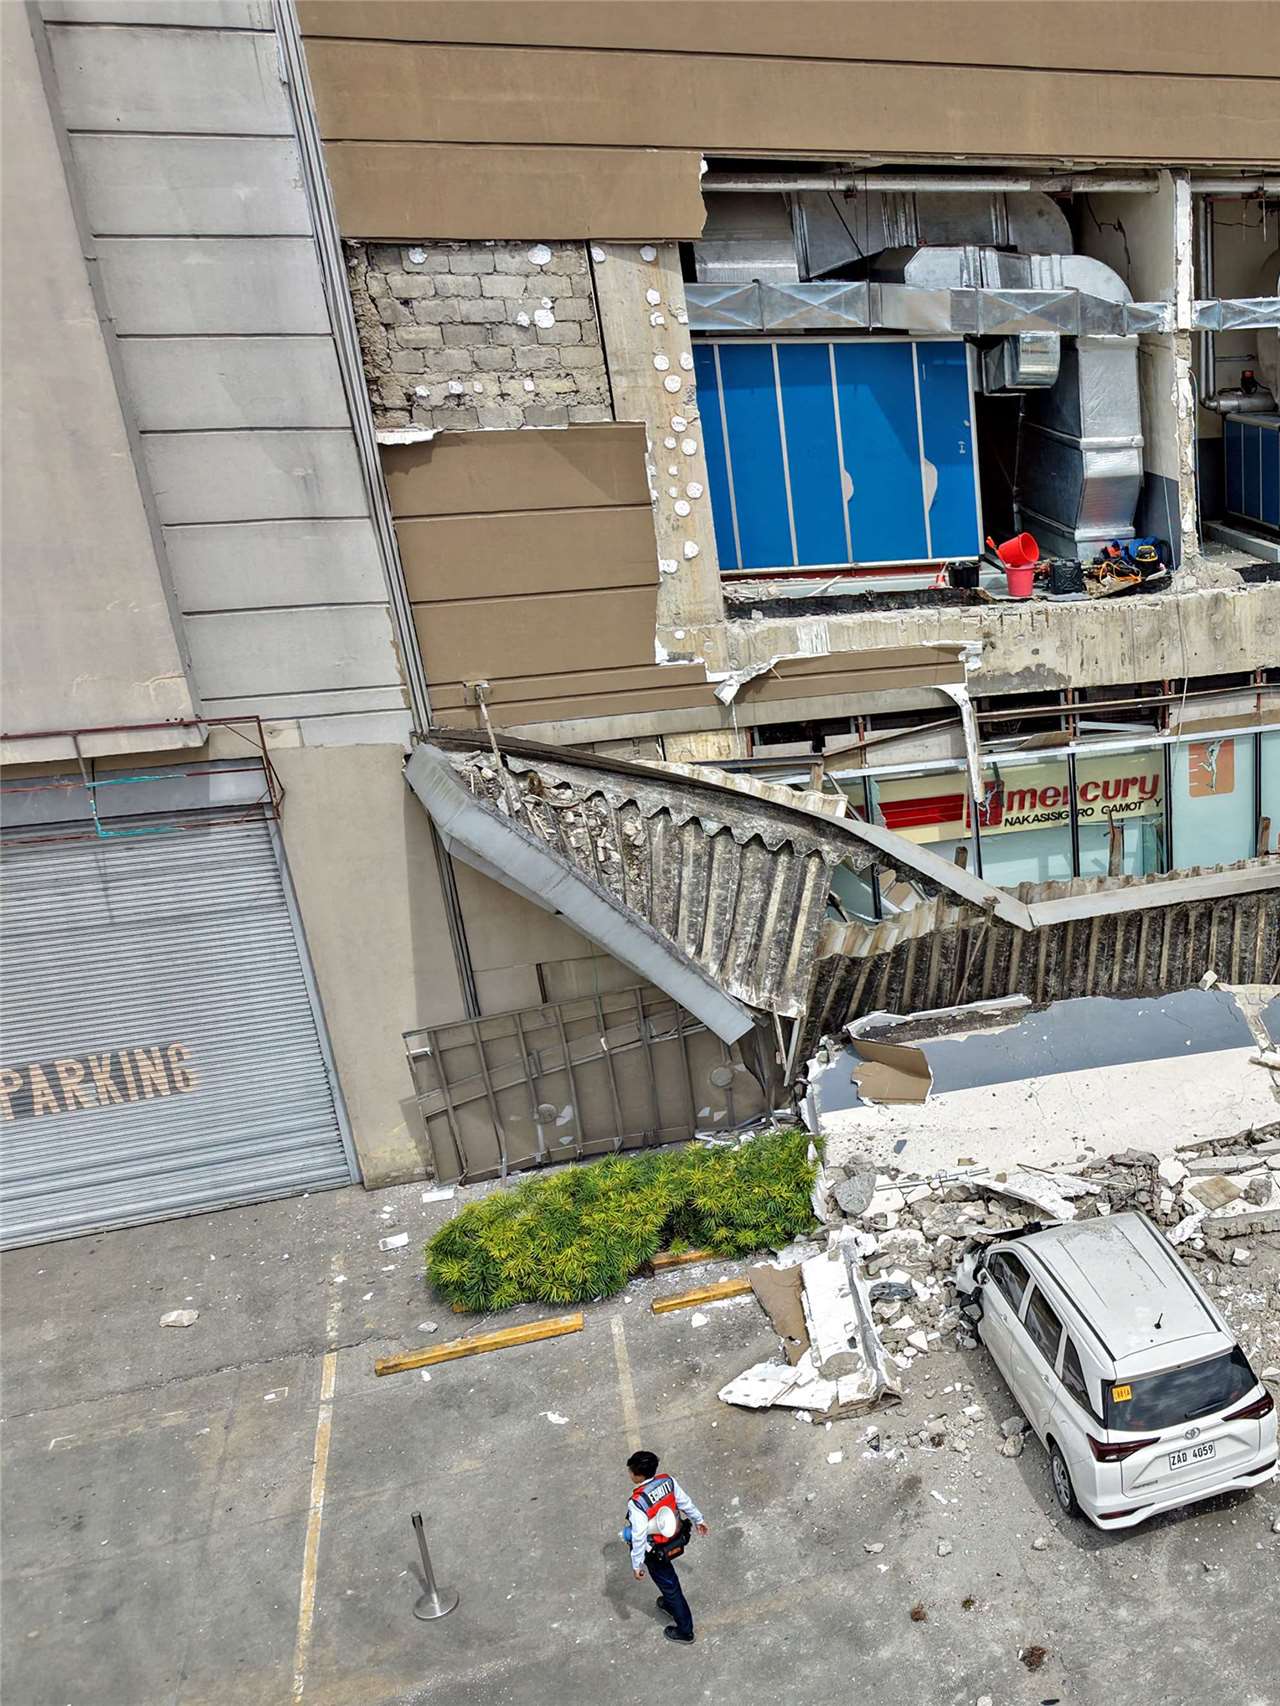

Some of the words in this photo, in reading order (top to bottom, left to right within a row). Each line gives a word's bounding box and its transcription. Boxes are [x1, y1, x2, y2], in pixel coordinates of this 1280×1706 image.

[1006, 774, 1160, 812] mercury
[1004, 807, 1095, 828] NAKASISIGRO
[1101, 800, 1145, 815] GAMOT
[0, 1040, 194, 1120] PARKING
[1170, 1452, 1188, 1466] ZAD
[1192, 1444, 1214, 1460] 4059
